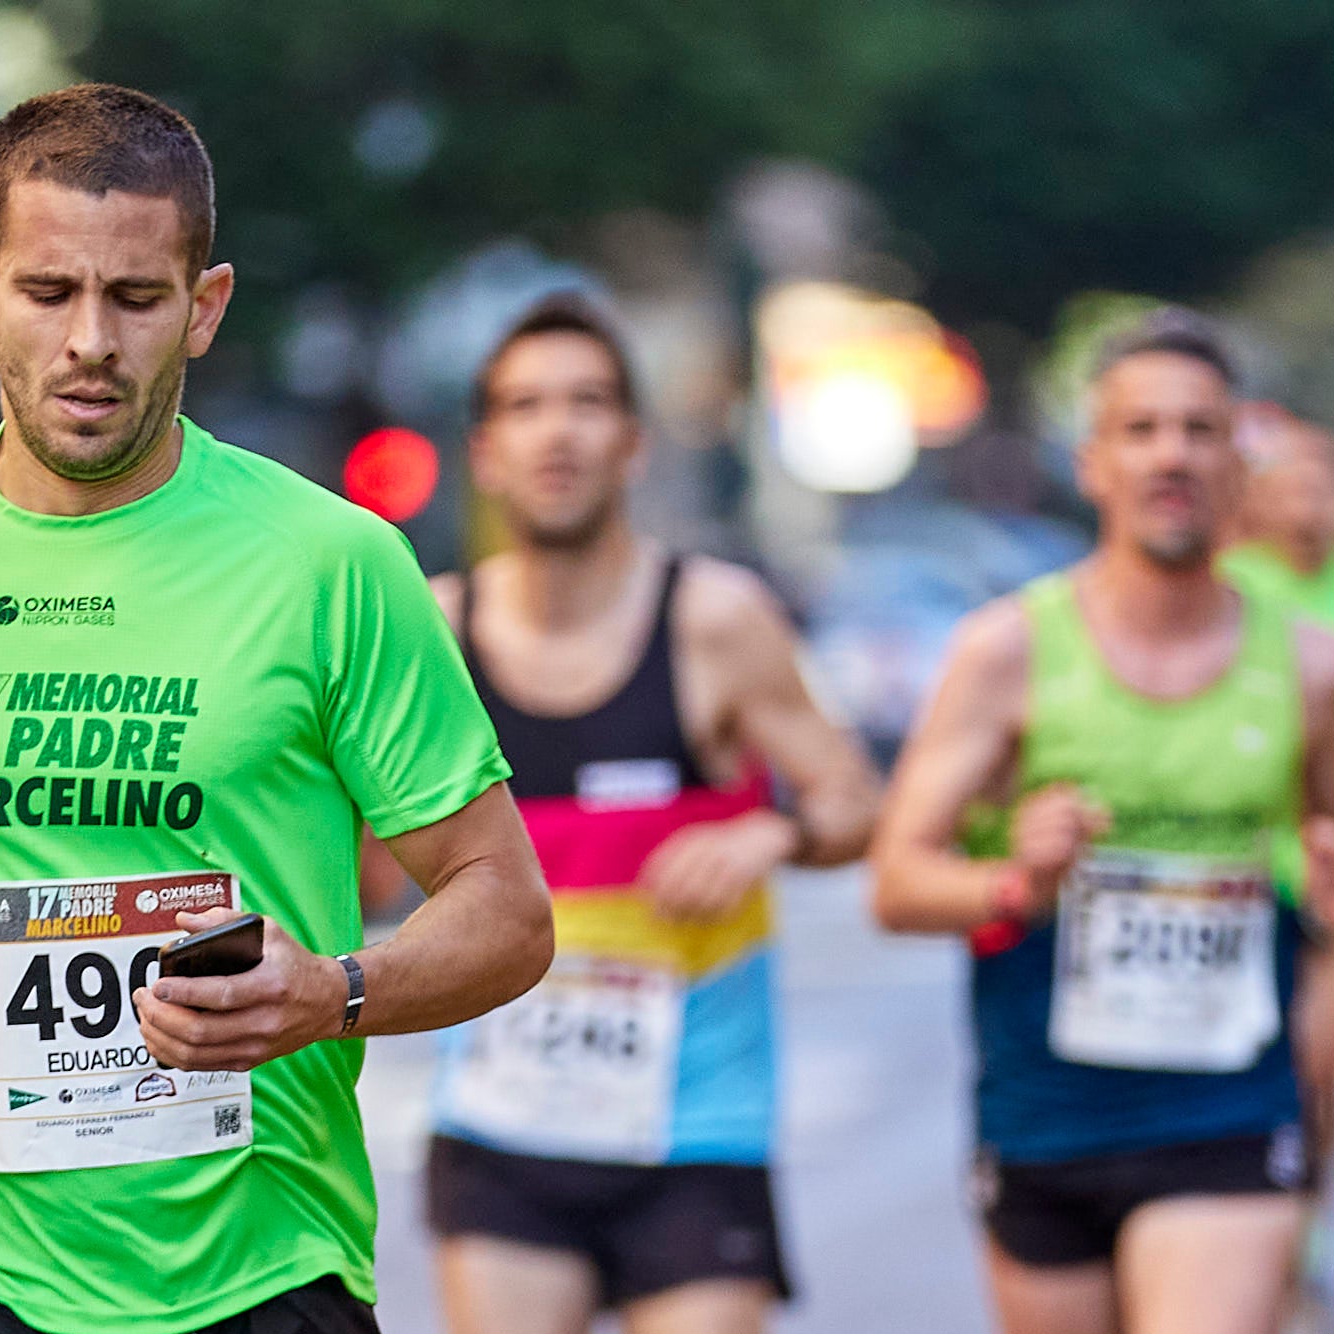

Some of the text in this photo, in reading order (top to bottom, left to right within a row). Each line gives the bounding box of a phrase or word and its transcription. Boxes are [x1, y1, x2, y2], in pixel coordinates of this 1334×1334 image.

[24, 596, 115, 611] OXIMESA
[22, 613, 115, 626] NIPPON GASES
[5, 672, 199, 716] MEMORIAL
[3, 716, 187, 772] PADRE
[27, 883, 117, 920] 17 MEMORIAL
[158, 883, 225, 901] OXIMESA
[60, 896, 115, 919] PADRE
[25, 913, 122, 938] MARCELINO
[47, 1044, 151, 1073] EDUARDO
[75, 1126, 114, 1138] SENIOR
